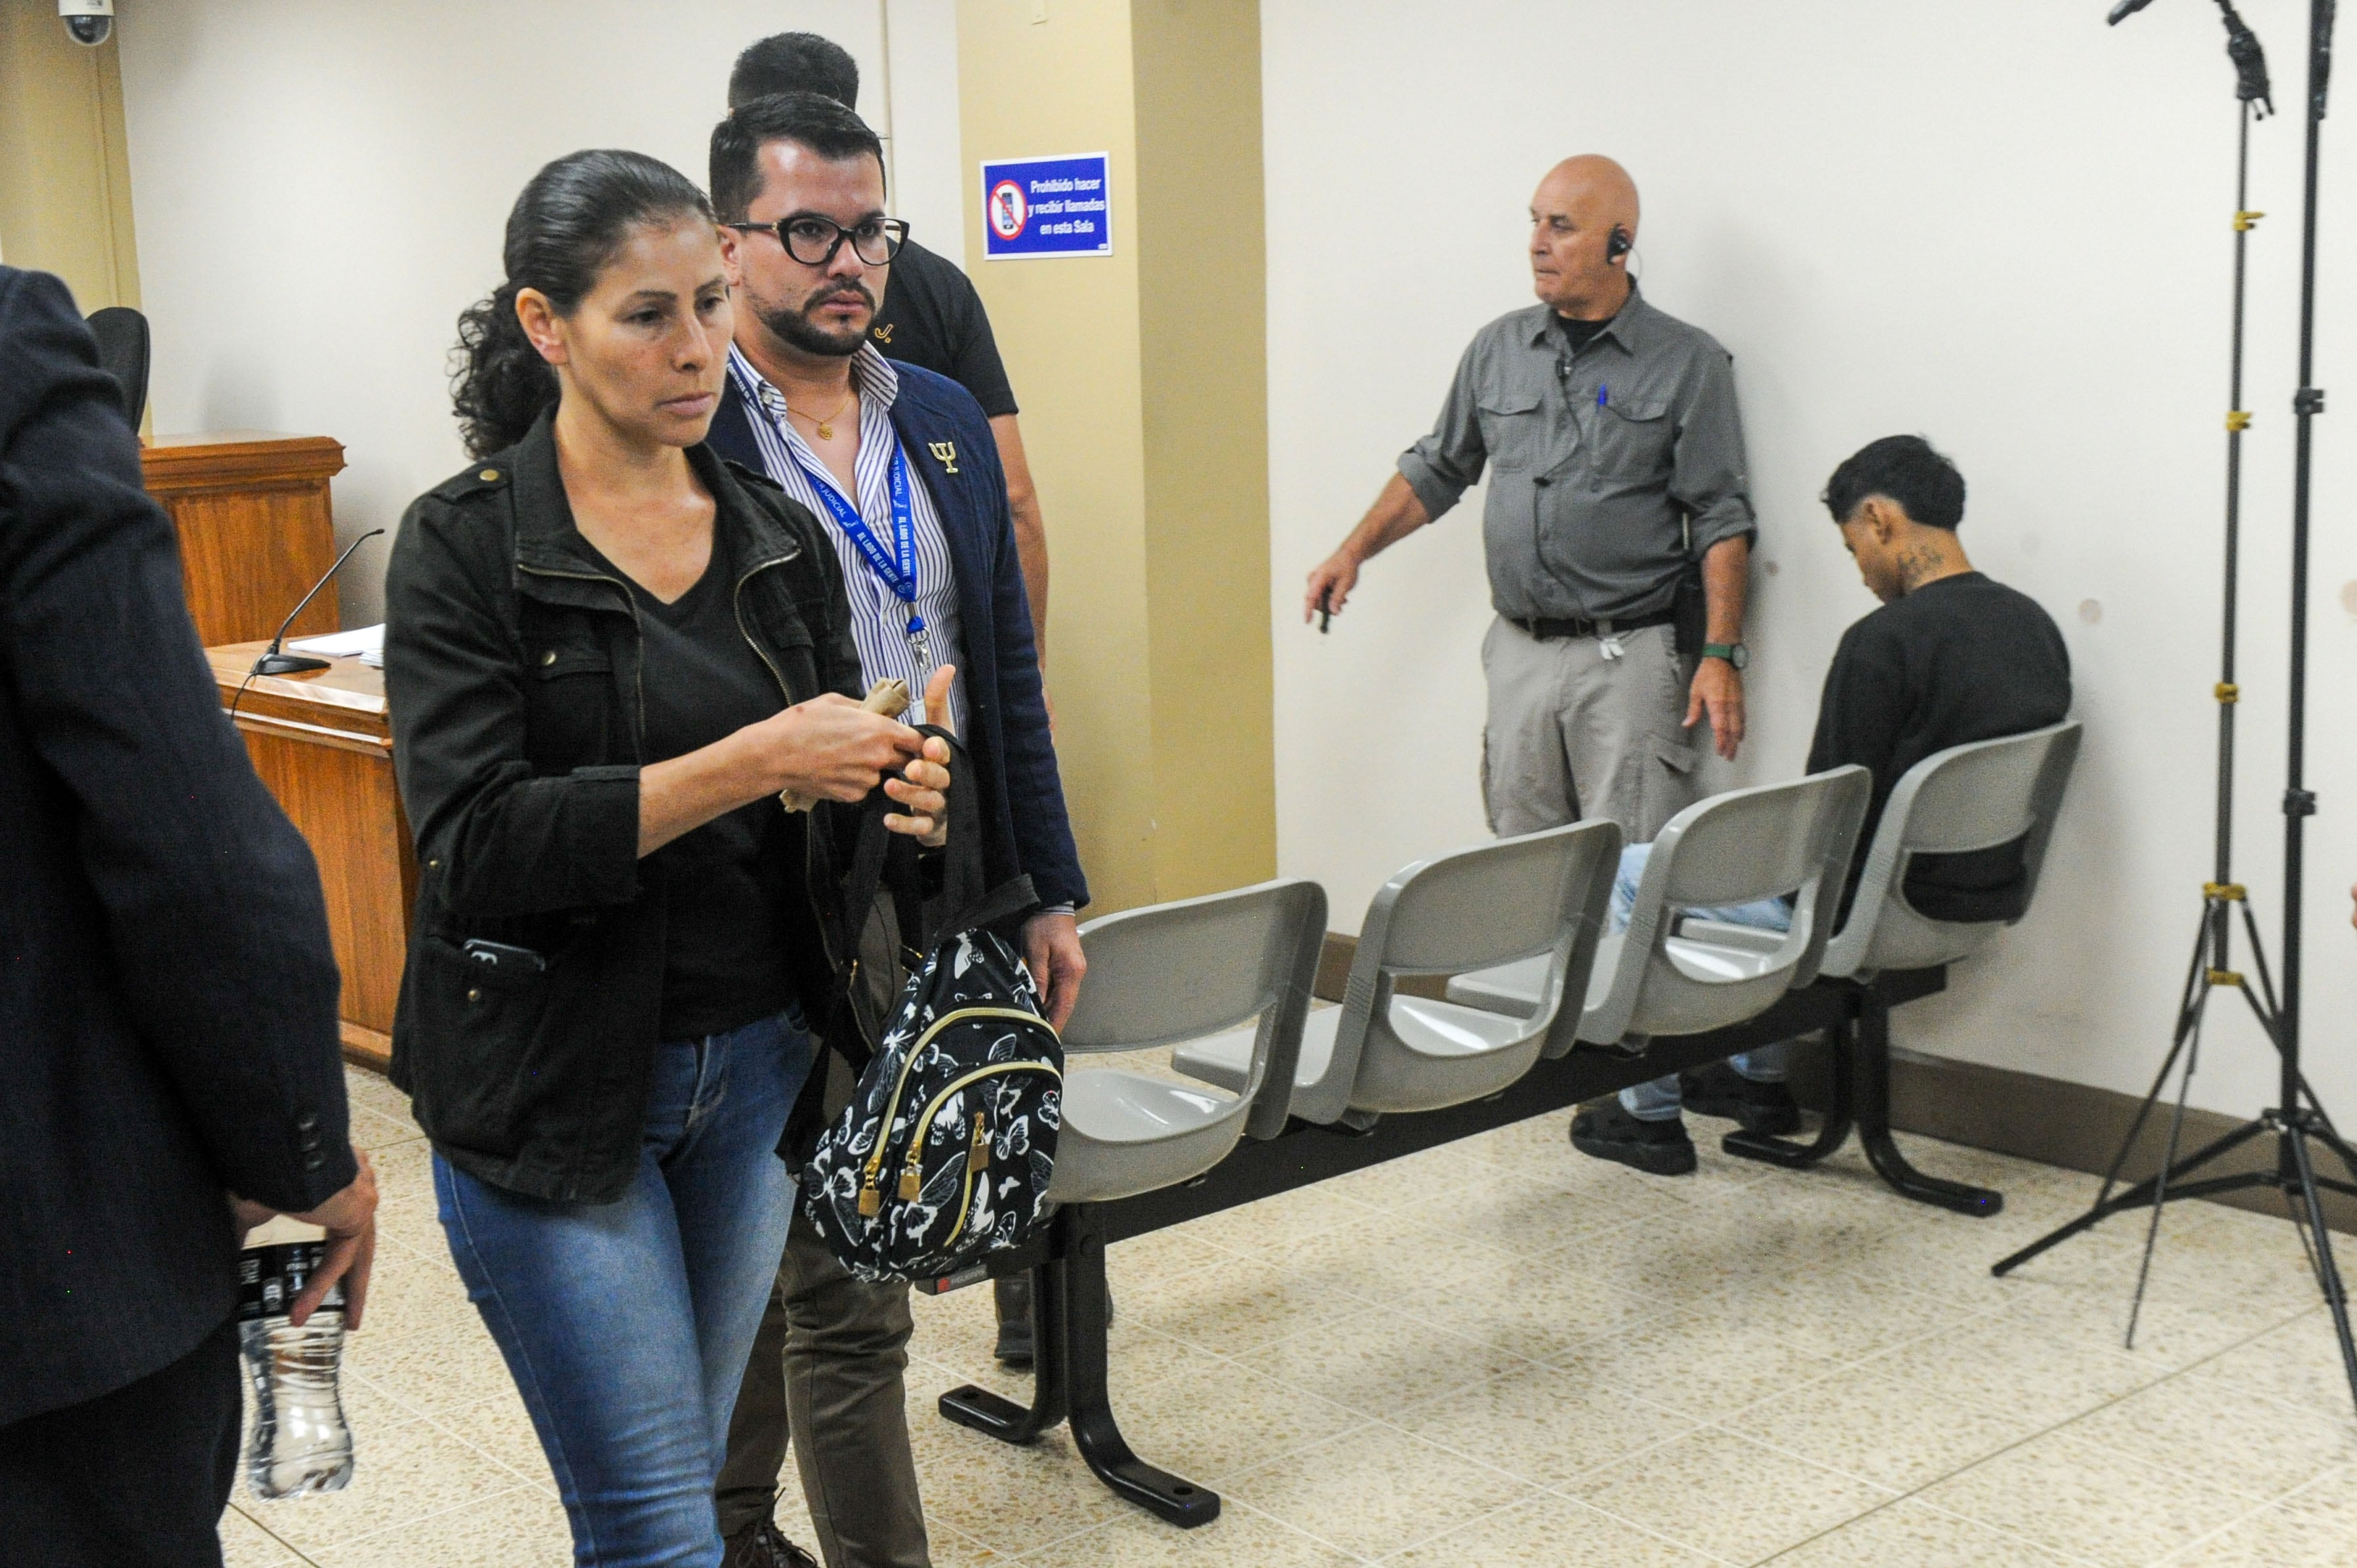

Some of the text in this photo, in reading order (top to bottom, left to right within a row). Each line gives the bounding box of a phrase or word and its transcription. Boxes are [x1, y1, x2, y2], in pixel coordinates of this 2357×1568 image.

[1030, 178, 1101, 193] Prohibido hacer
[1028, 198, 1105, 218] y recibir llamadas
[1039, 220, 1095, 235] en esta Sala
[821, 488, 847, 518] JUDICIAL
[899, 525, 908, 540] LADO
[856, 532, 899, 583] AL LADO DE LA GENTE
[902, 559, 910, 576] GENTE
